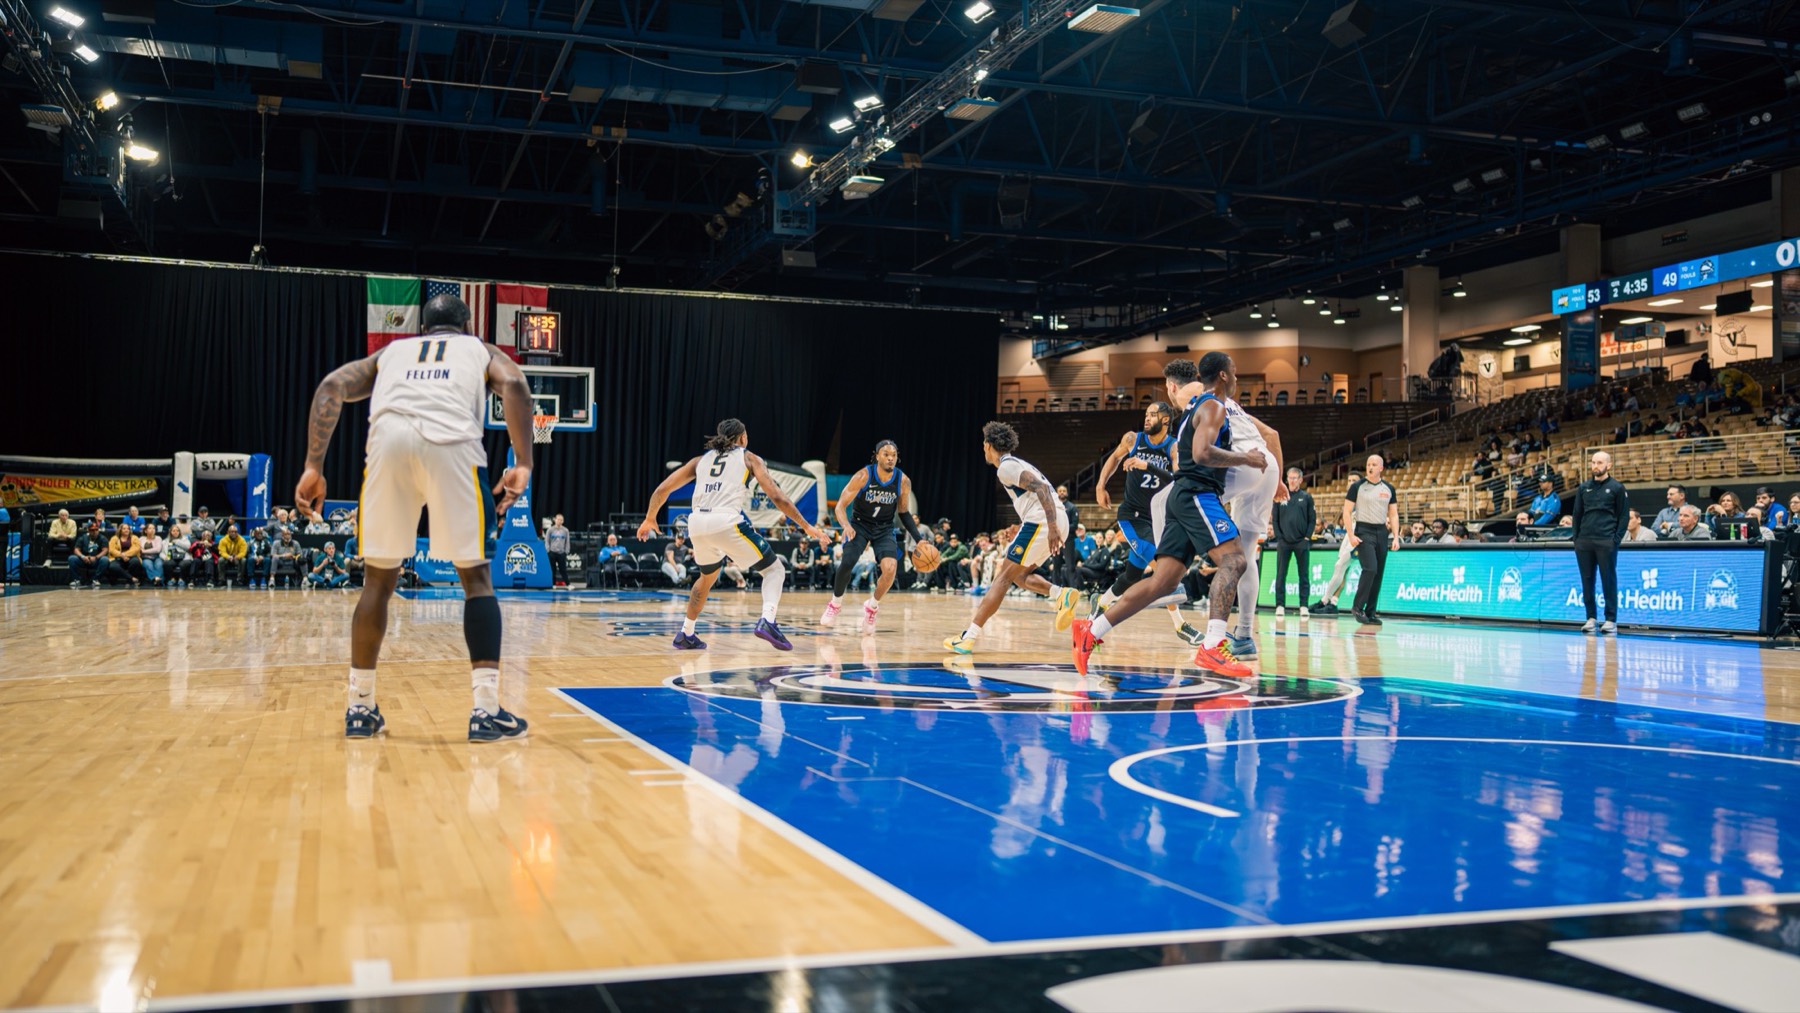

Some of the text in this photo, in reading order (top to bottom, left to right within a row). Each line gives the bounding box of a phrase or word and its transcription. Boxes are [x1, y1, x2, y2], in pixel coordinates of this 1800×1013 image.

[1662, 272, 1678, 287] 49
[1612, 278, 1648, 298] 2 4:35
[1587, 288, 1601, 304] 53
[529, 315, 556, 329] 4:35
[533, 329, 552, 349] 17
[417, 340, 448, 363] 11
[406, 368, 450, 380] FELTON
[201, 459, 244, 471] START
[709, 454, 729, 477] 5
[74, 479, 120, 490] MOUSE
[123, 479, 153, 490] TRAP
[1140, 473, 1160, 489] 23
[872, 506, 881, 518] 1
